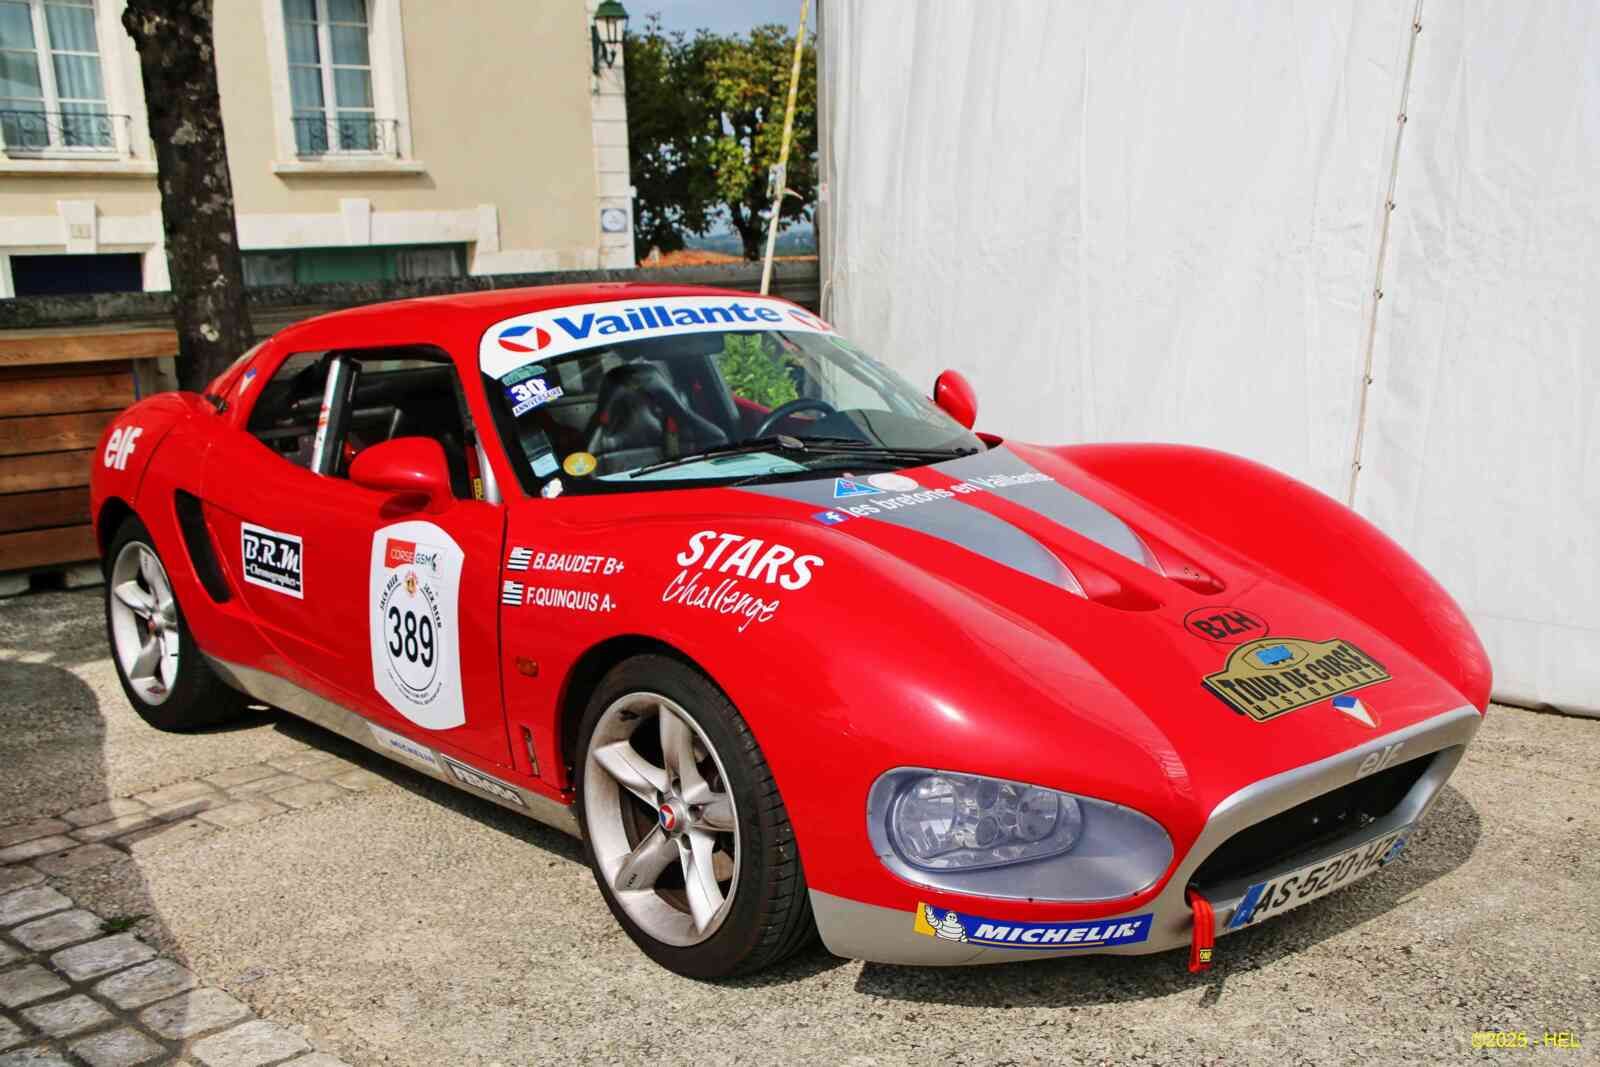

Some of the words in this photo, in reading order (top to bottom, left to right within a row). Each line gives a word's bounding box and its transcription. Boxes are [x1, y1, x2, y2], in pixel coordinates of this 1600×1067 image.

[552, 303, 783, 340] Vaillante
[104, 426, 144, 471] elf
[836, 500, 880, 519] les
[868, 487, 956, 513] bretons
[950, 477, 982, 495] en
[390, 548, 414, 562] CORSE
[532, 552, 605, 574] B.BAUDET
[602, 557, 625, 576] B+
[676, 530, 825, 591] STARS
[526, 587, 599, 612] F.QUINQUIS
[599, 594, 617, 613] A-
[662, 569, 780, 632] Challenge
[389, 606, 434, 668] 389
[1192, 611, 1262, 640] BZH
[1215, 674, 1294, 705] TOUR
[1279, 667, 1317, 689] DE
[1304, 643, 1372, 682] CORSE
[1358, 742, 1405, 777] elf
[974, 920, 1142, 944] MICHELIN
